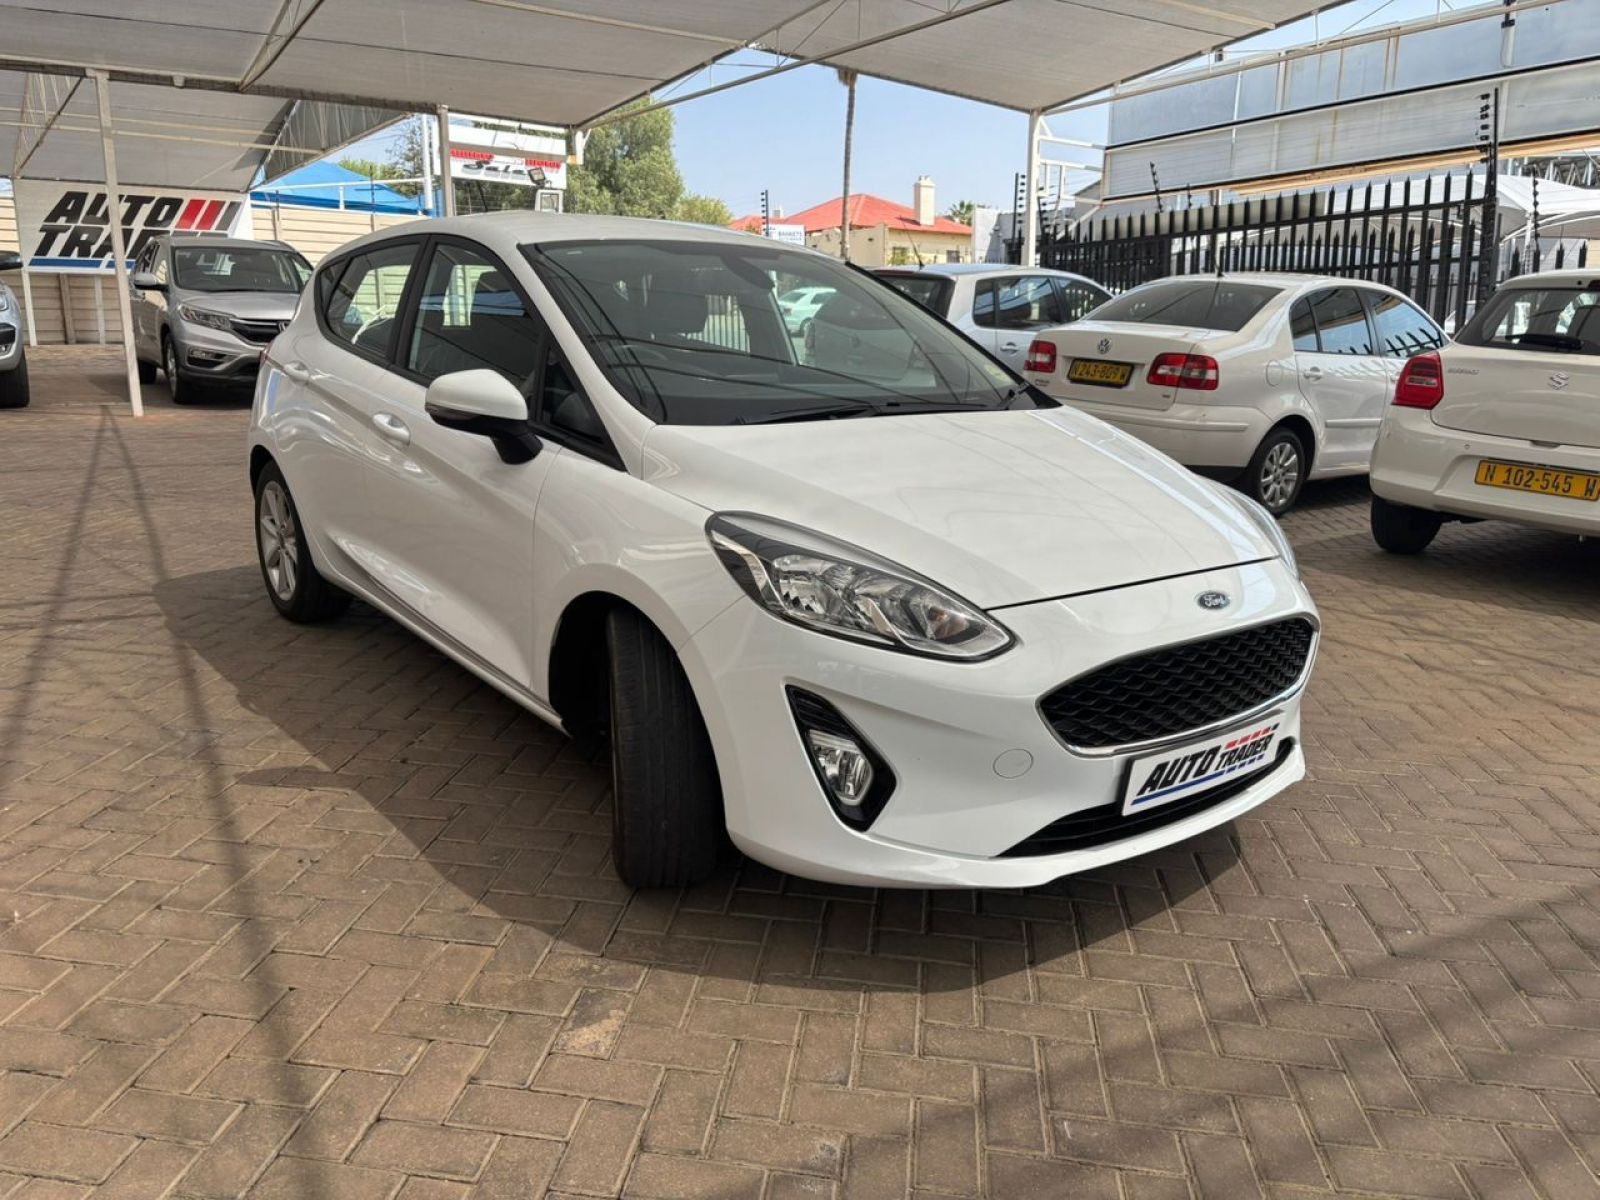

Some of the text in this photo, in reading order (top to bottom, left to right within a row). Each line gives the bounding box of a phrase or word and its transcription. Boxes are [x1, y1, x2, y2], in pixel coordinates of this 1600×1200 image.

[43, 190, 185, 228] AUTO
[33, 224, 228, 259] TRA
[1484, 464, 1597, 497] N 102-545 W
[1136, 733, 1275, 796] AUTO TRADER
